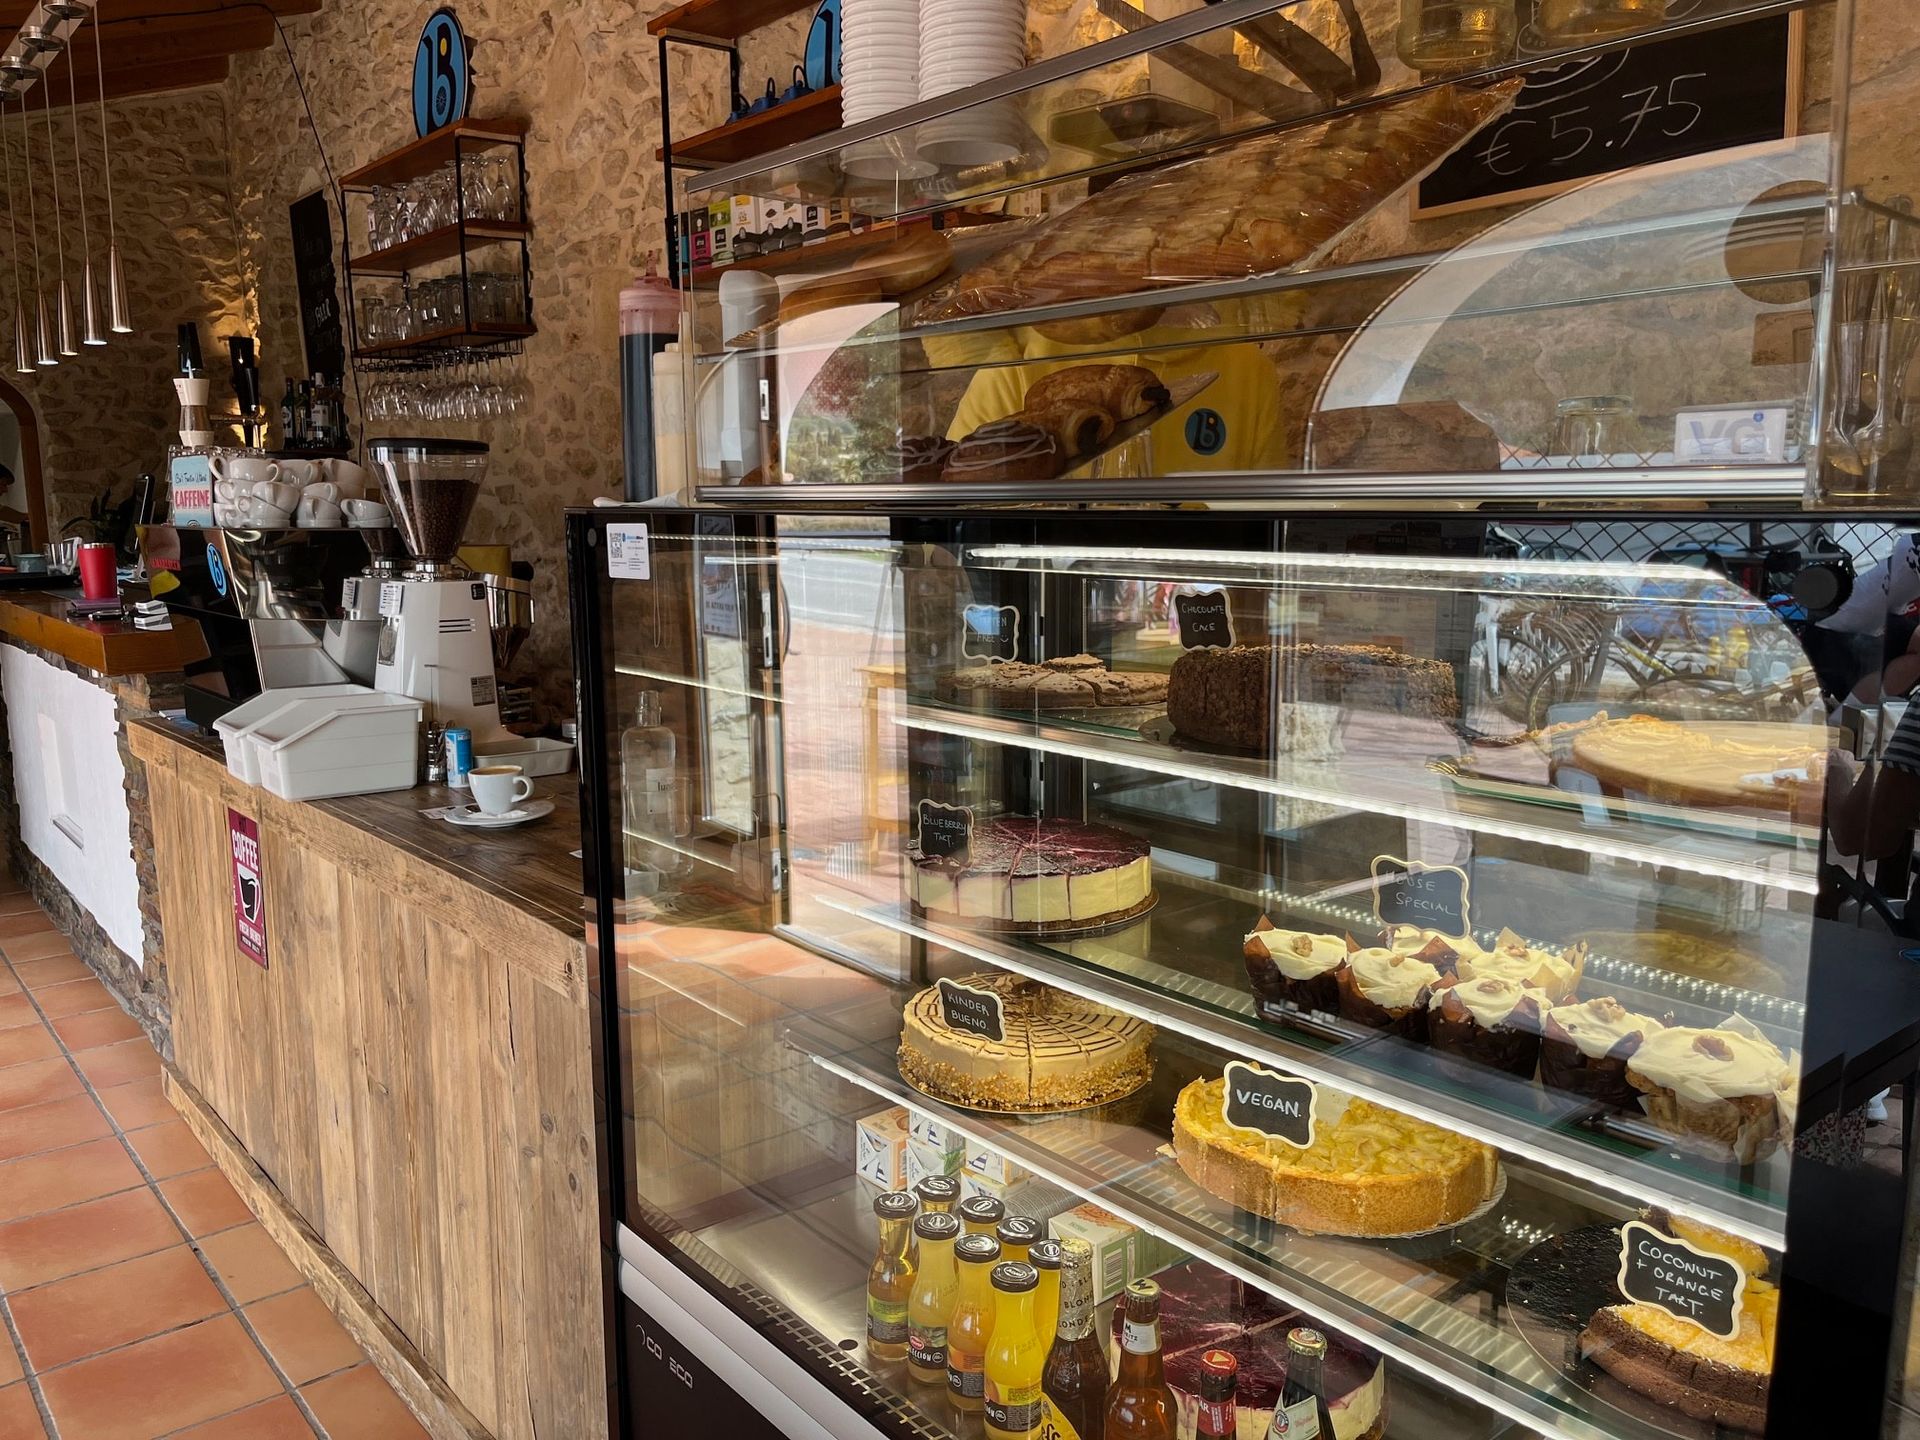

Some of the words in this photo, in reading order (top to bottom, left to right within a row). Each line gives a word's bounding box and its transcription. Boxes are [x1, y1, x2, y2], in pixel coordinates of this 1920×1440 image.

[175, 490, 210, 509] CAFFEINE
[1181, 602, 1225, 615] CHOCOLATE
[1191, 622, 1216, 633] CAKE
[922, 813, 967, 836] BLUEBERRY
[231, 829, 259, 873] COFFEE
[1395, 891, 1459, 916] SPECIAL
[947, 992, 990, 1017] KINDER
[1638, 1240, 1723, 1280] COCONUT
[1653, 1266, 1724, 1301] ORANGE
[669, 1356, 693, 1390] ECO
